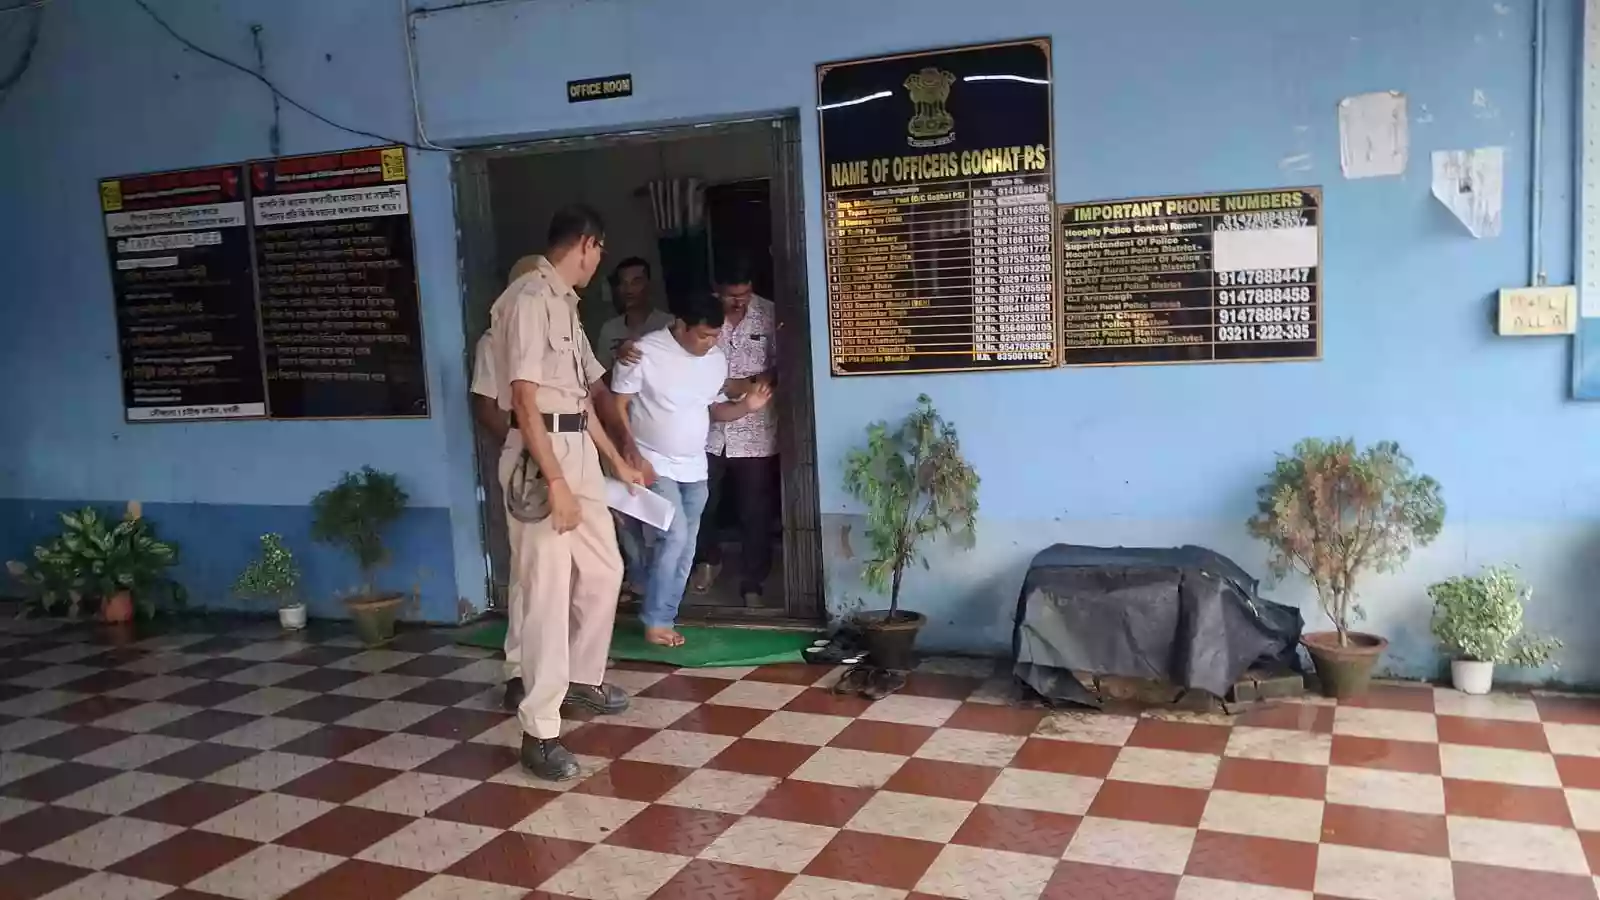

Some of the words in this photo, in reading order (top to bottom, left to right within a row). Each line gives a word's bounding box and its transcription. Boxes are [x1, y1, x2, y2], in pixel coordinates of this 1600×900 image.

[571, 82, 602, 97] OFFICE
[603, 79, 630, 94] ROOM
[831, 160, 869, 187] NAME
[871, 158, 889, 183] OF
[892, 152, 958, 181] OFFICERS
[961, 146, 1020, 175] GOGHAT
[1074, 201, 1163, 222] IMPORTANT
[1166, 197, 1220, 216] PHONE
[1226, 192, 1303, 211] NUMBERS
[1065, 227, 1101, 237] Hooghly
[1103, 226, 1131, 235] Police
[1133, 222, 1168, 233] Control
[1065, 240, 1134, 251] Superintendent
[1149, 236, 1179, 246] Police
[1218, 268, 1309, 286] 9147888447
[1218, 286, 1311, 305] 9147888458
[1101, 320, 1132, 329] Police
[1133, 319, 1169, 327] Station
[1218, 306, 1311, 324] 9147888475
[1101, 329, 1132, 338] Police
[1133, 336, 1165, 344] Police
[1167, 334, 1204, 343] District
[1218, 323, 1310, 341] 03211-222-335
